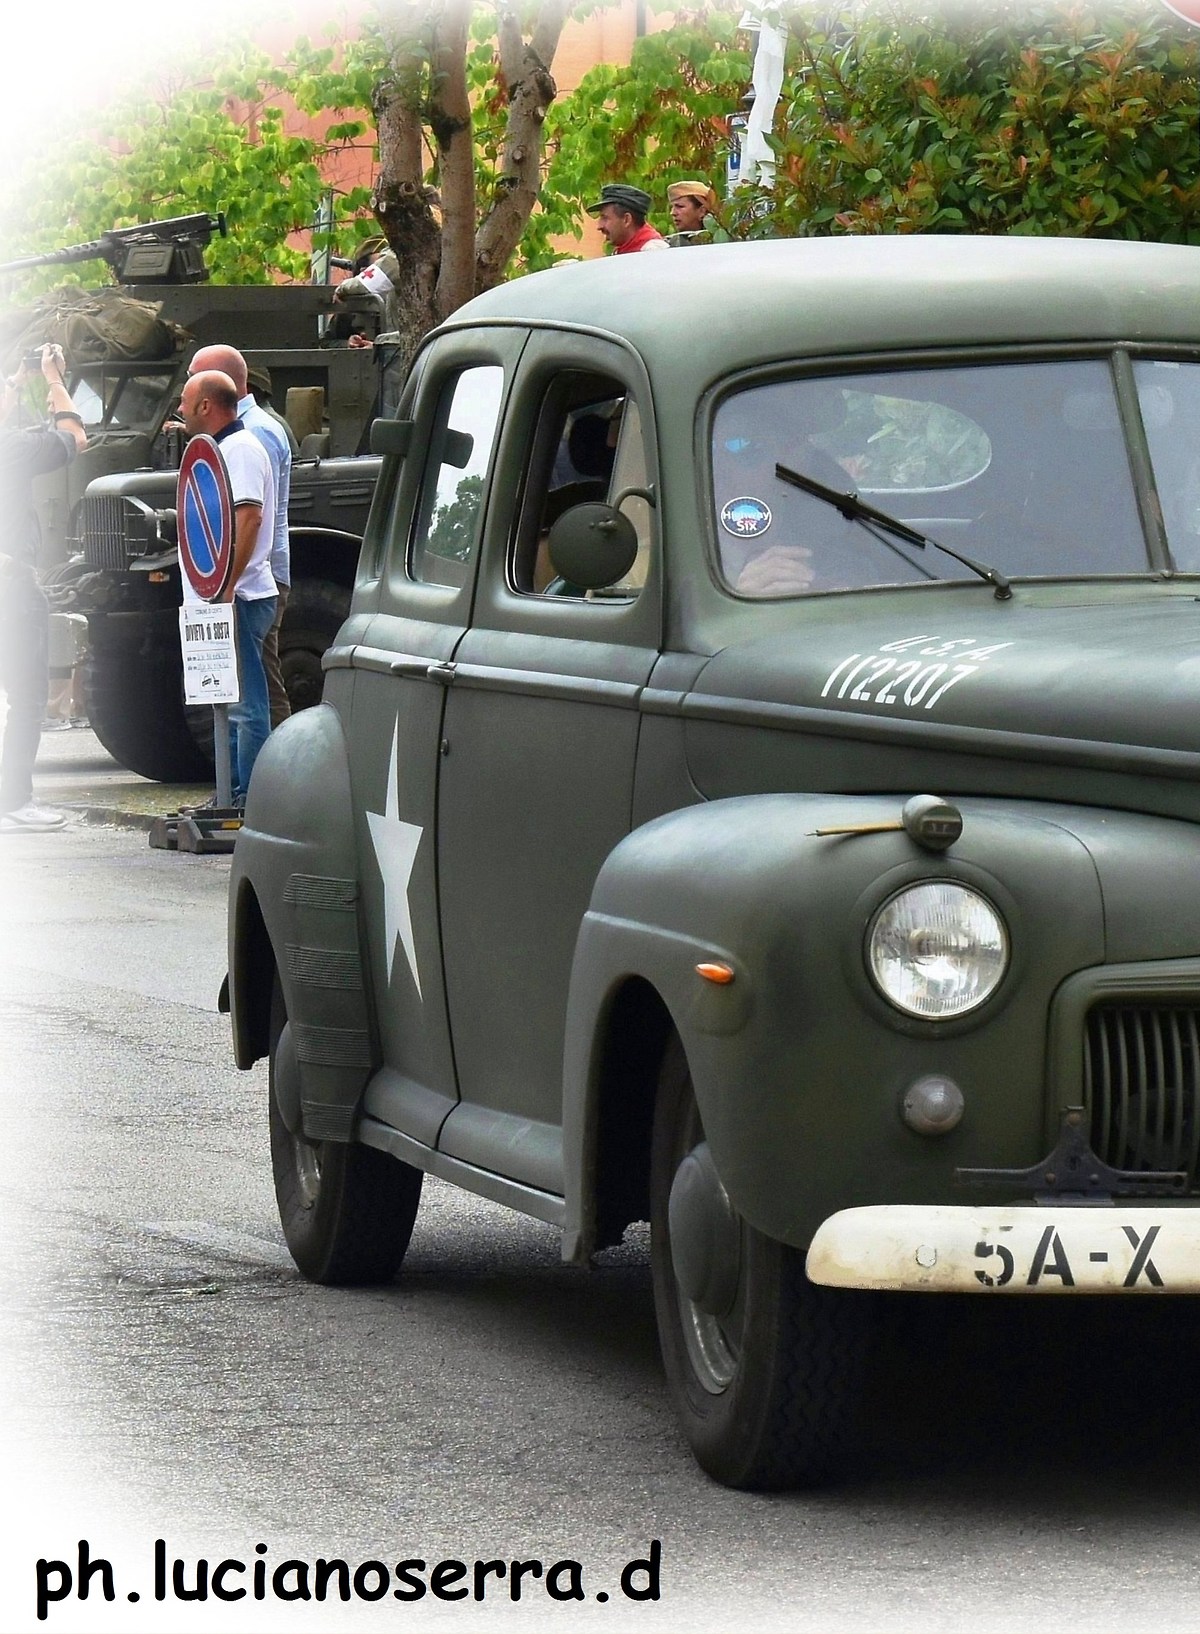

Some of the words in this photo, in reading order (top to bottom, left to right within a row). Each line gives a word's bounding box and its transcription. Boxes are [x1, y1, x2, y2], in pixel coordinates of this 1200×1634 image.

[185, 623, 205, 642] DIVIETO
[213, 621, 230, 640] SOSTA
[821, 654, 979, 709] 112207
[974, 1225, 1164, 1287] 5A-X
